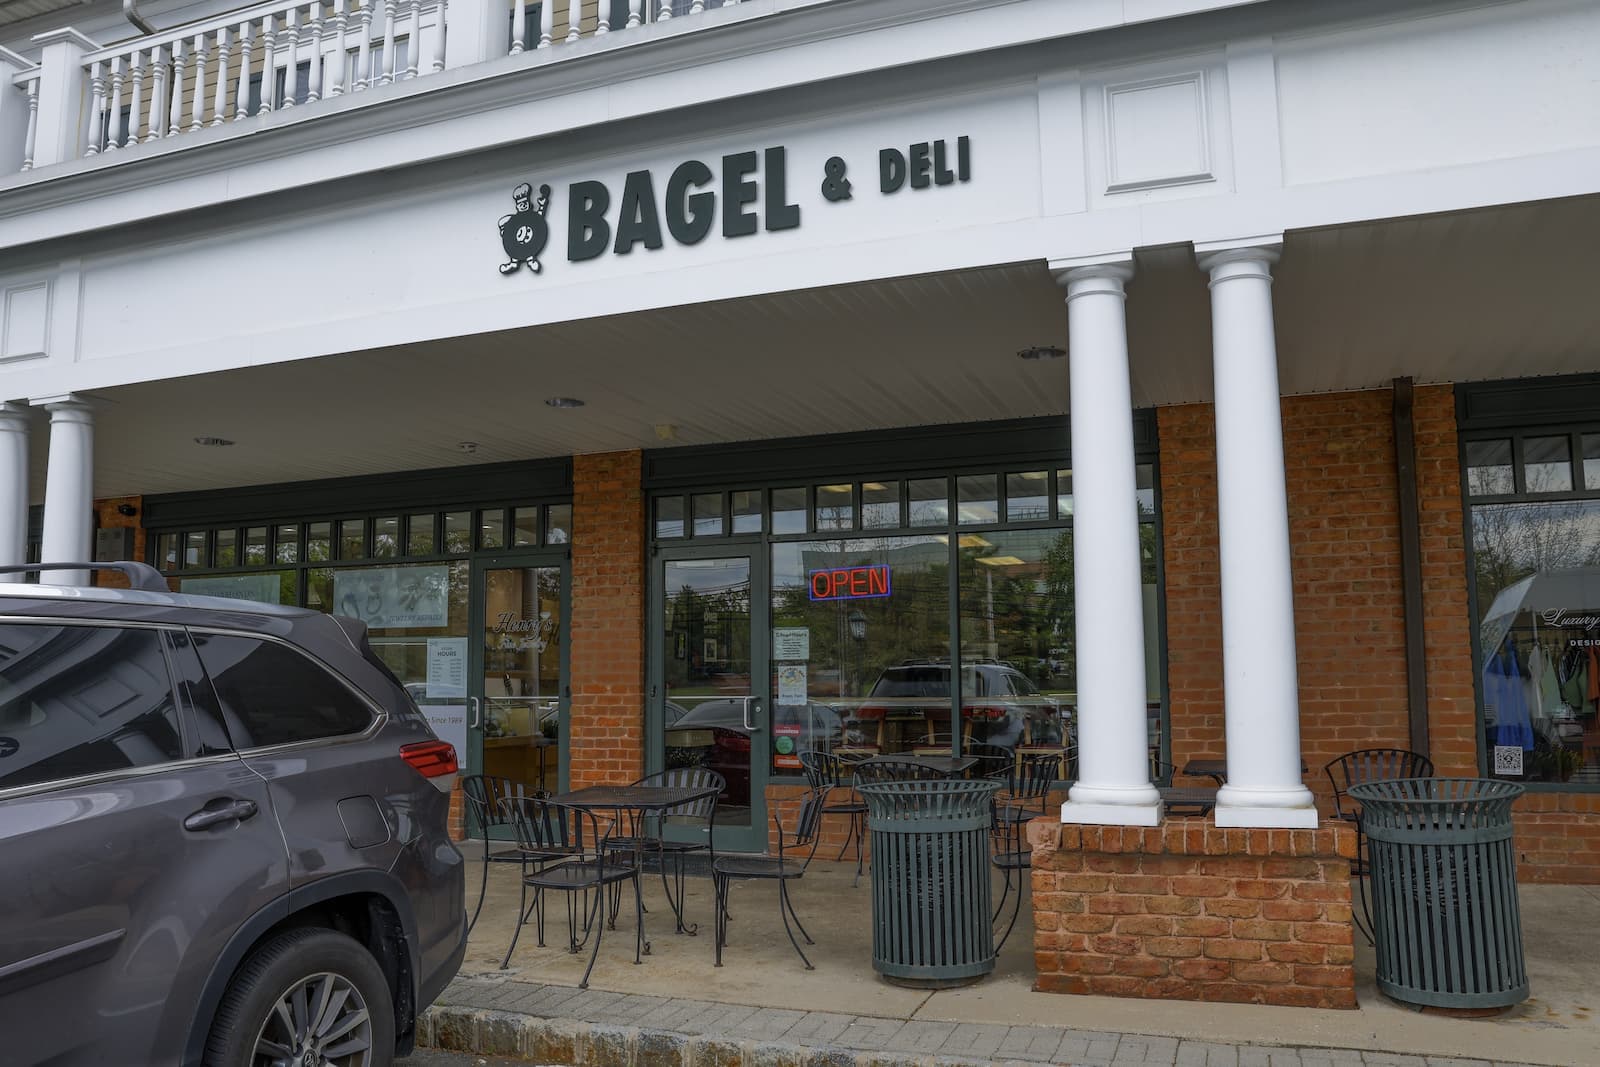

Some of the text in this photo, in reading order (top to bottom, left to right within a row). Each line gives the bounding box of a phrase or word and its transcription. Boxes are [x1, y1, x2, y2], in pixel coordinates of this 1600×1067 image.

[567, 135, 971, 262] BAGEL & DELI
[812, 567, 887, 598] OPEN
[495, 611, 553, 641] Henry's
[1541, 607, 1600, 632] Luxury
